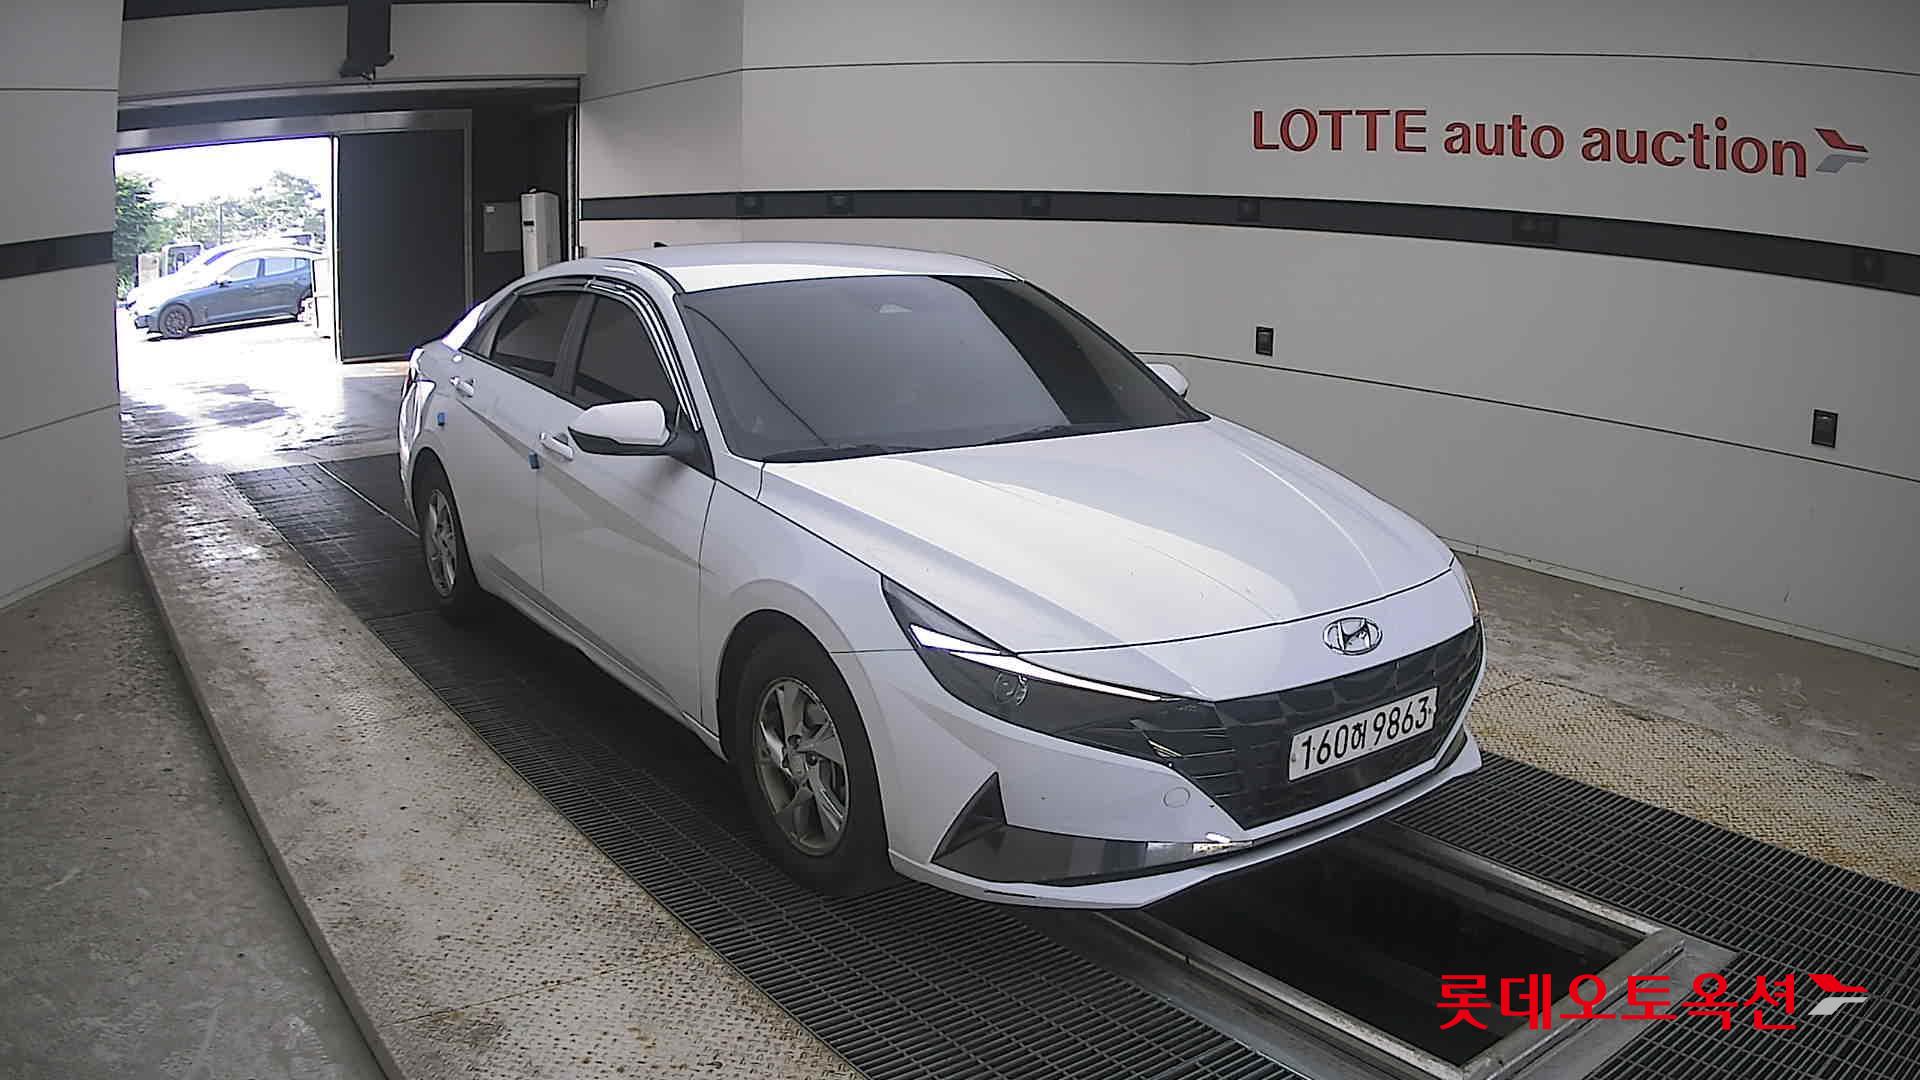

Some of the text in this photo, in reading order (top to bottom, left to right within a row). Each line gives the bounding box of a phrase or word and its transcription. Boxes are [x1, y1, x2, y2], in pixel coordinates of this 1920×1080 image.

[1252, 109, 1808, 178] LOTTE auto auction
